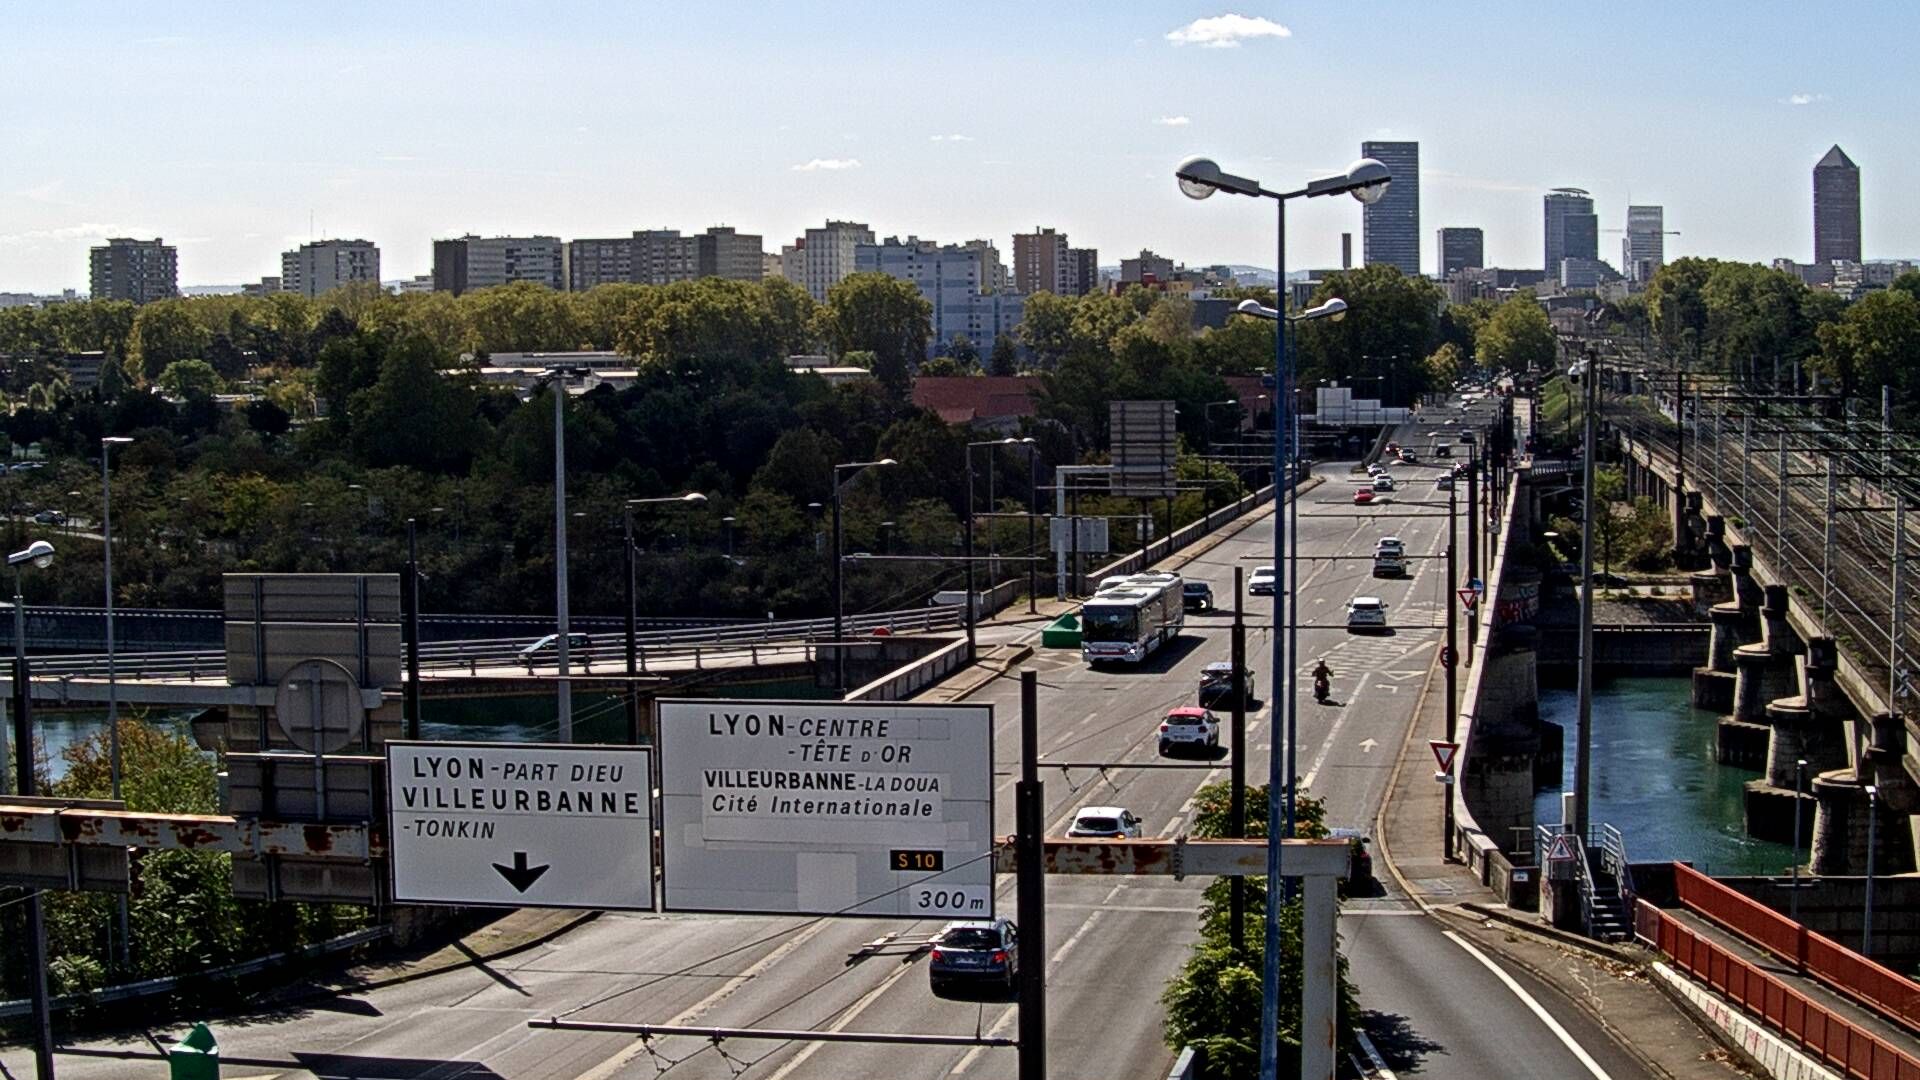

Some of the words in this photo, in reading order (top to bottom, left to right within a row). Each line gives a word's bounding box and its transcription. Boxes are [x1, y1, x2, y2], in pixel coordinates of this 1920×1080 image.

[570, 763, 624, 783] DIEU
[889, 776, 940, 793] DOUA
[402, 786, 640, 814] VILLEURBANNE
[711, 794, 758, 813] Cité
[770, 795, 934, 817] Internationale
[917, 890, 966, 909] 300
[969, 897, 984, 910] m
